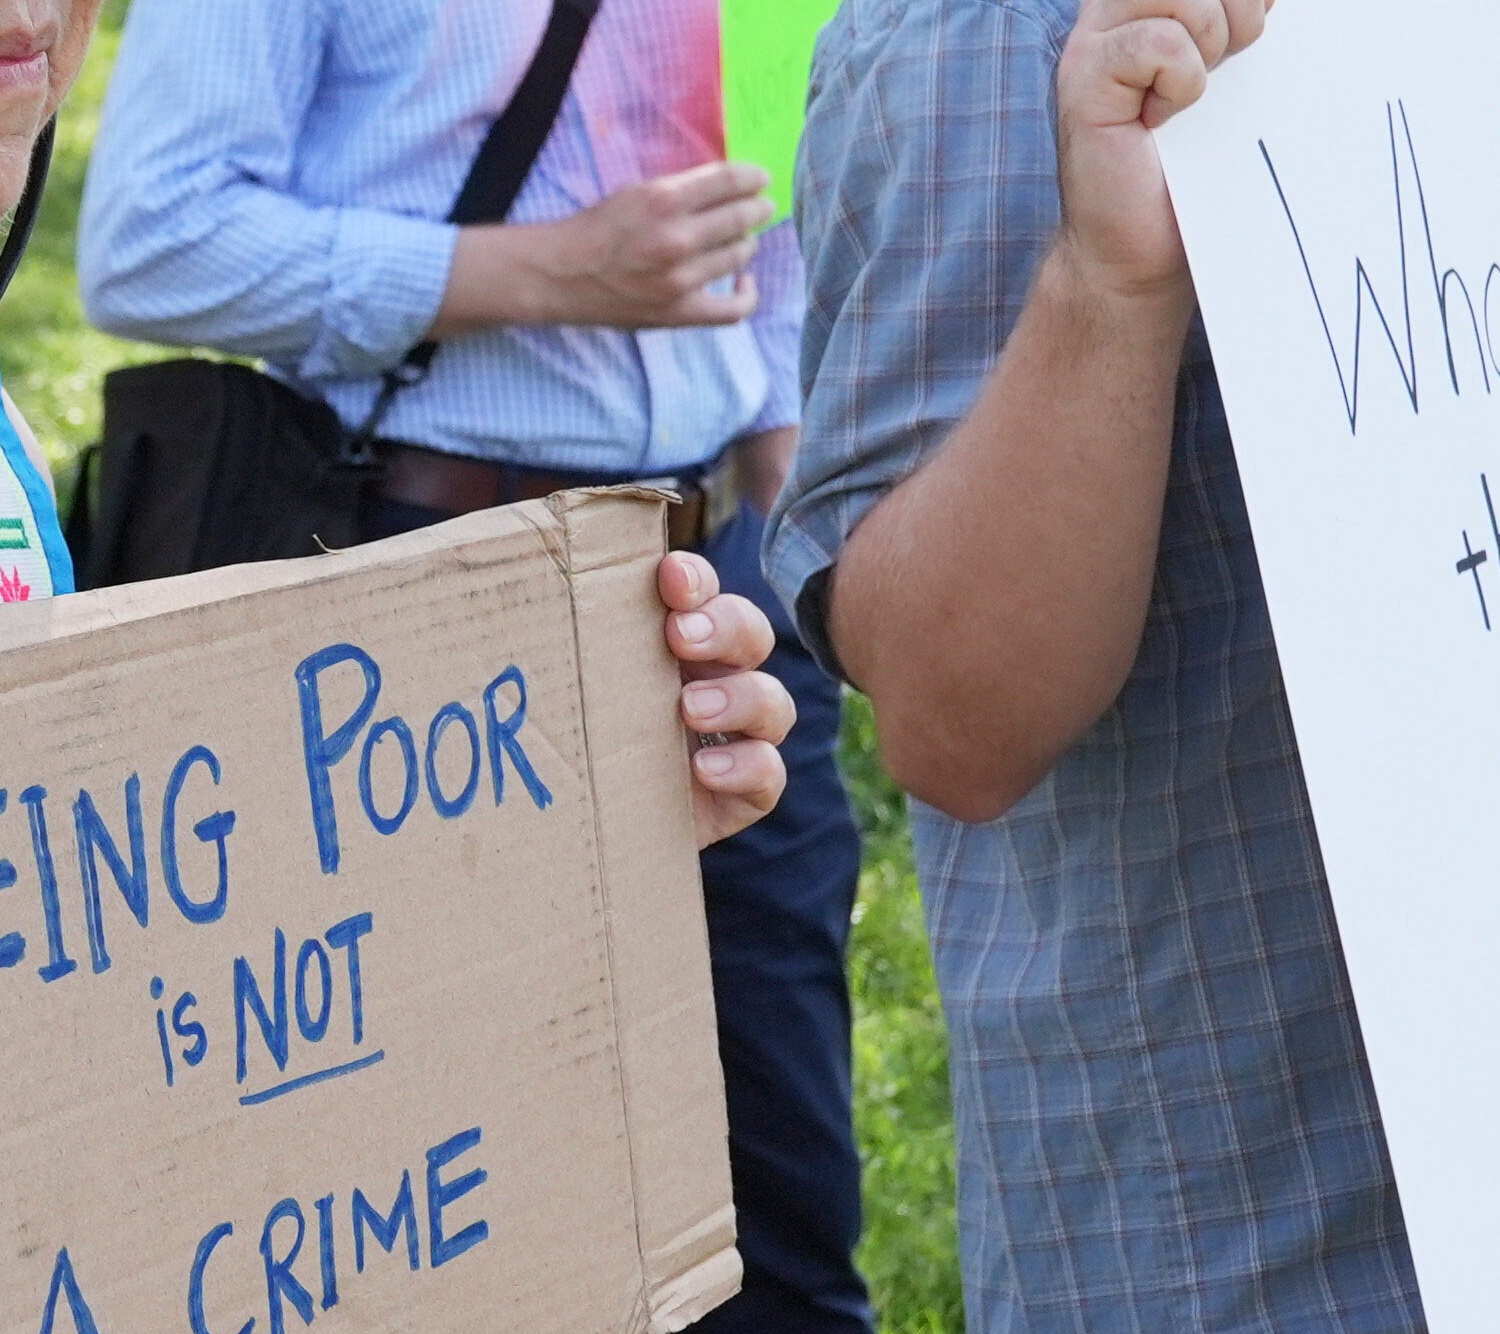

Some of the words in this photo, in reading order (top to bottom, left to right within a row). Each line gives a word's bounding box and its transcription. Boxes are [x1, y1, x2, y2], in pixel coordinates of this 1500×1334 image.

[293, 642, 554, 875] POOR
[155, 977, 208, 1088] is
[233, 911, 374, 1086] NOT
